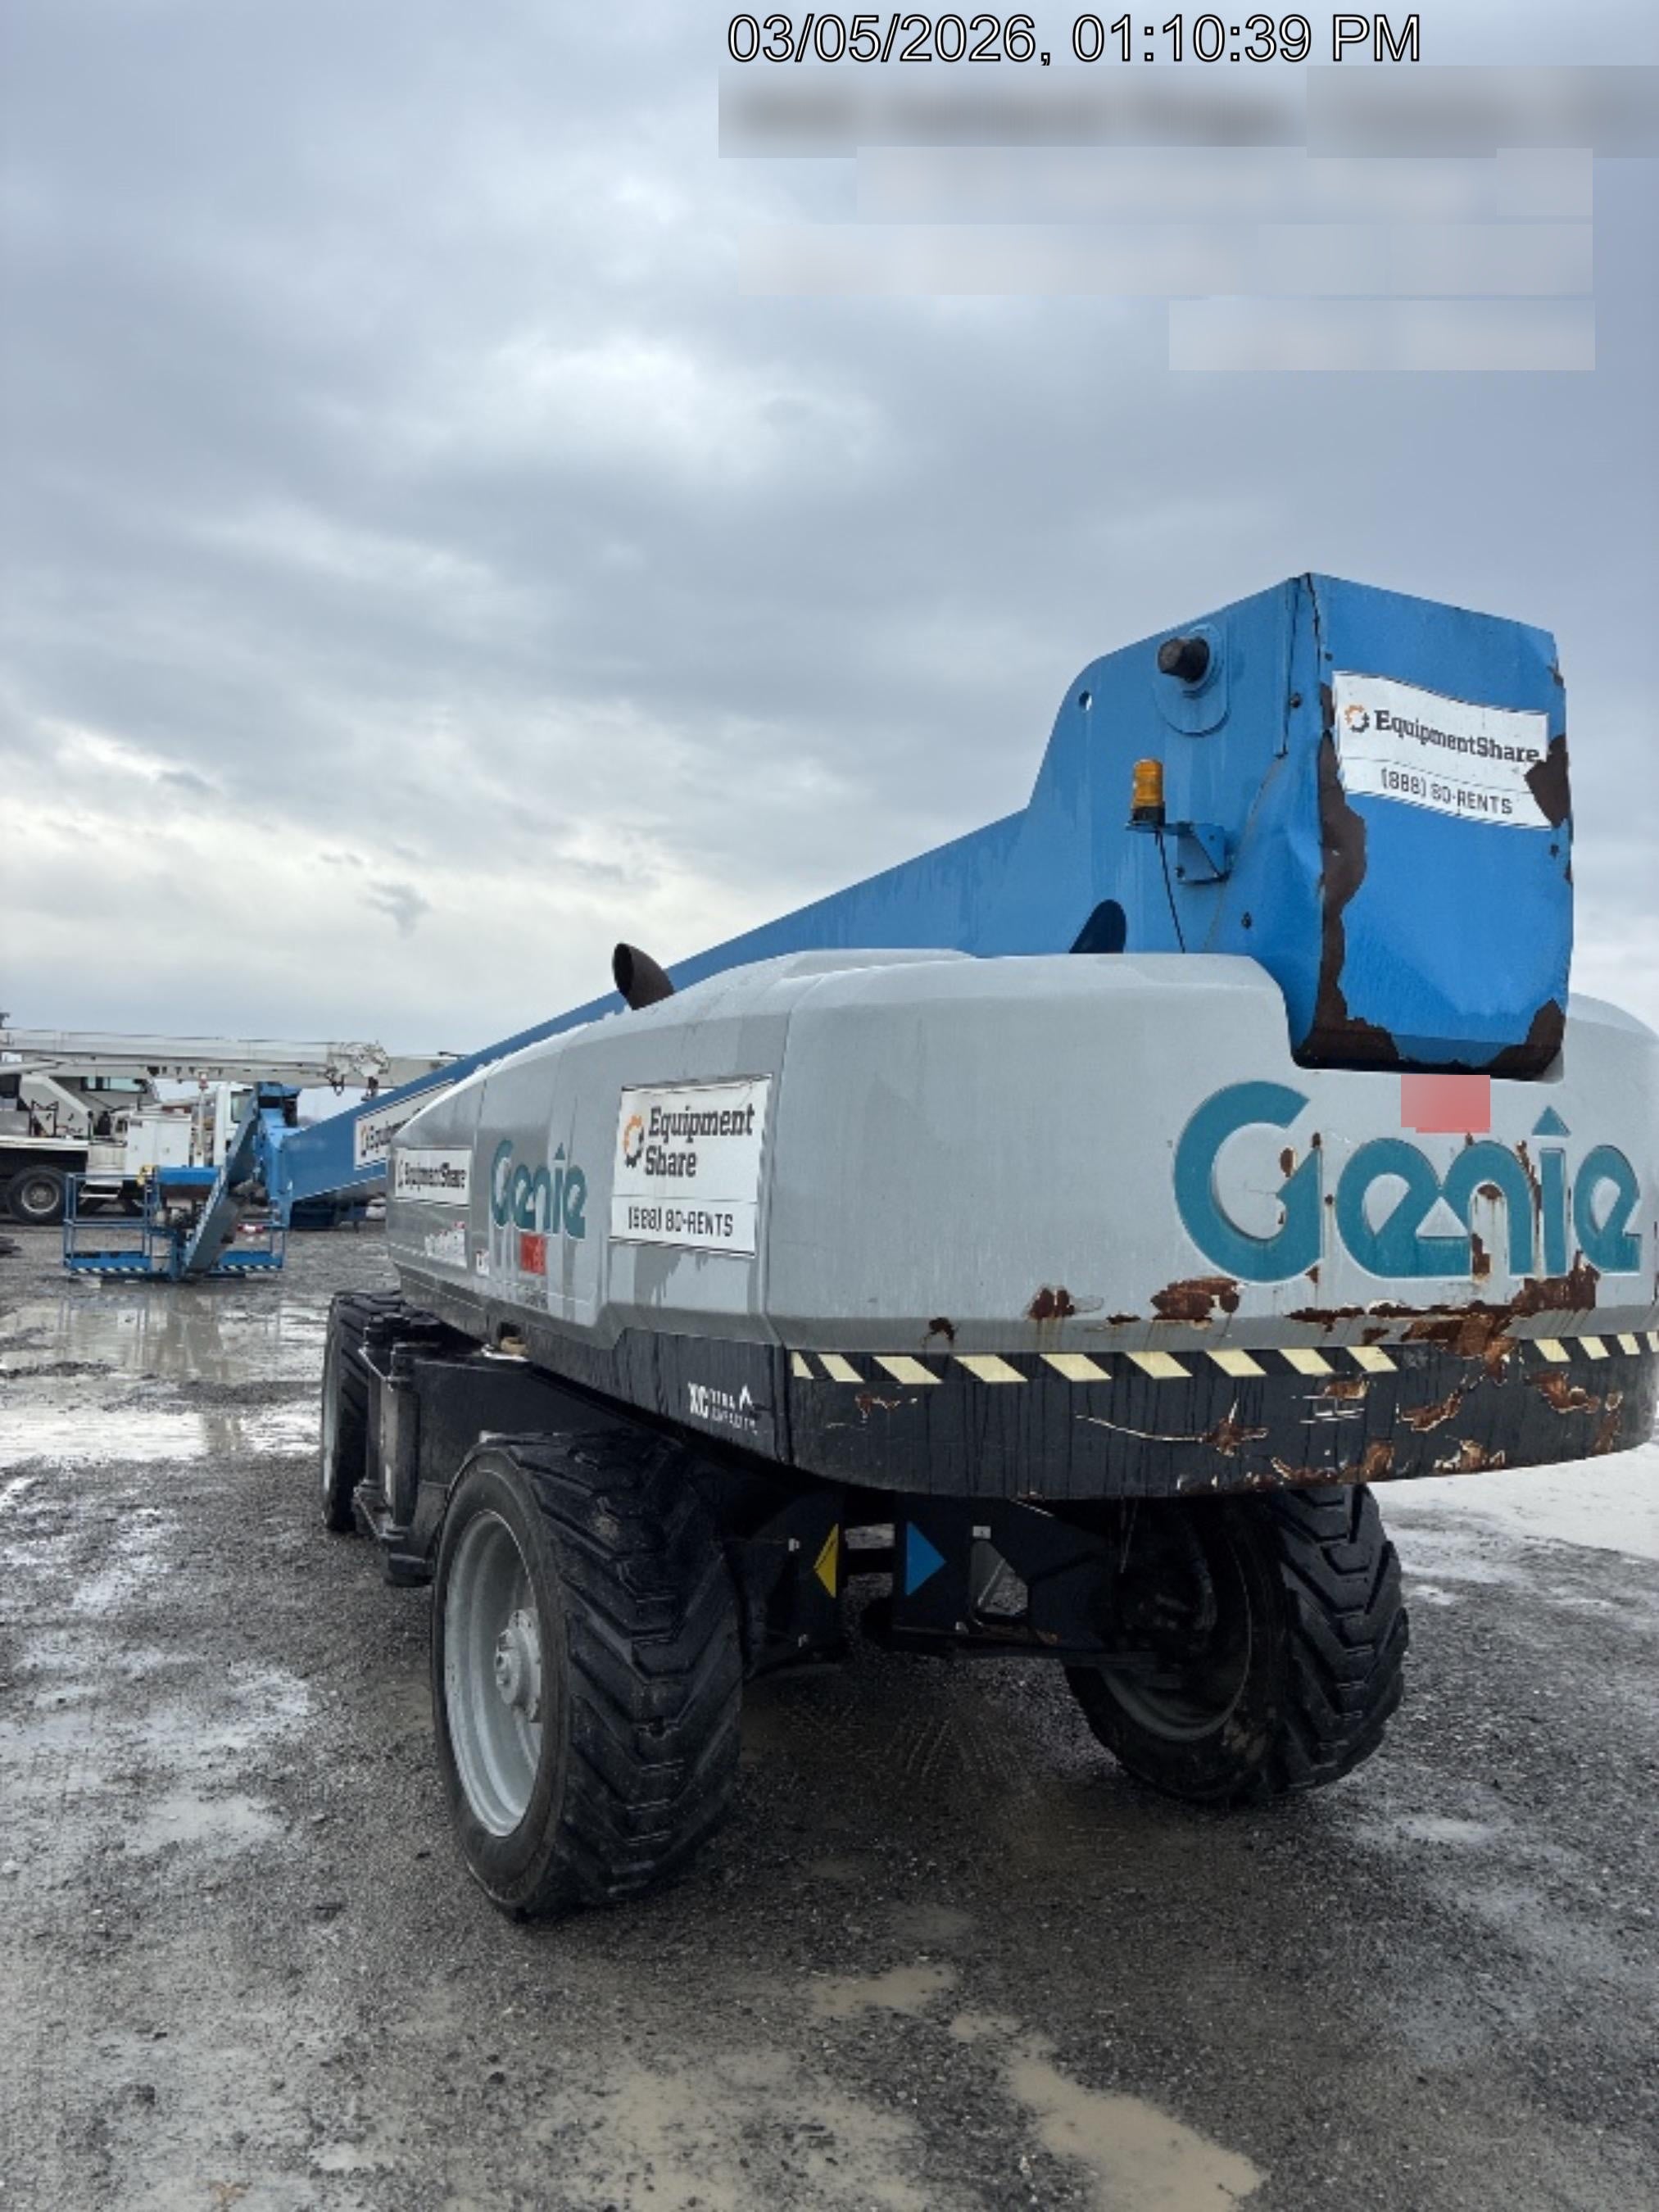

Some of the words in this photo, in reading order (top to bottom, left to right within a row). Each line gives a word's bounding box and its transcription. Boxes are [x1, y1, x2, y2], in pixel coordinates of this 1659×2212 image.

[1374, 709, 1540, 762] EquipmentShare
[1380, 768, 1426, 798] (888)
[648, 1104, 755, 1145] Equipment
[645, 1145, 696, 1177] Share
[1174, 1081, 1643, 1283] Genie
[492, 1139, 587, 1240] Genie
